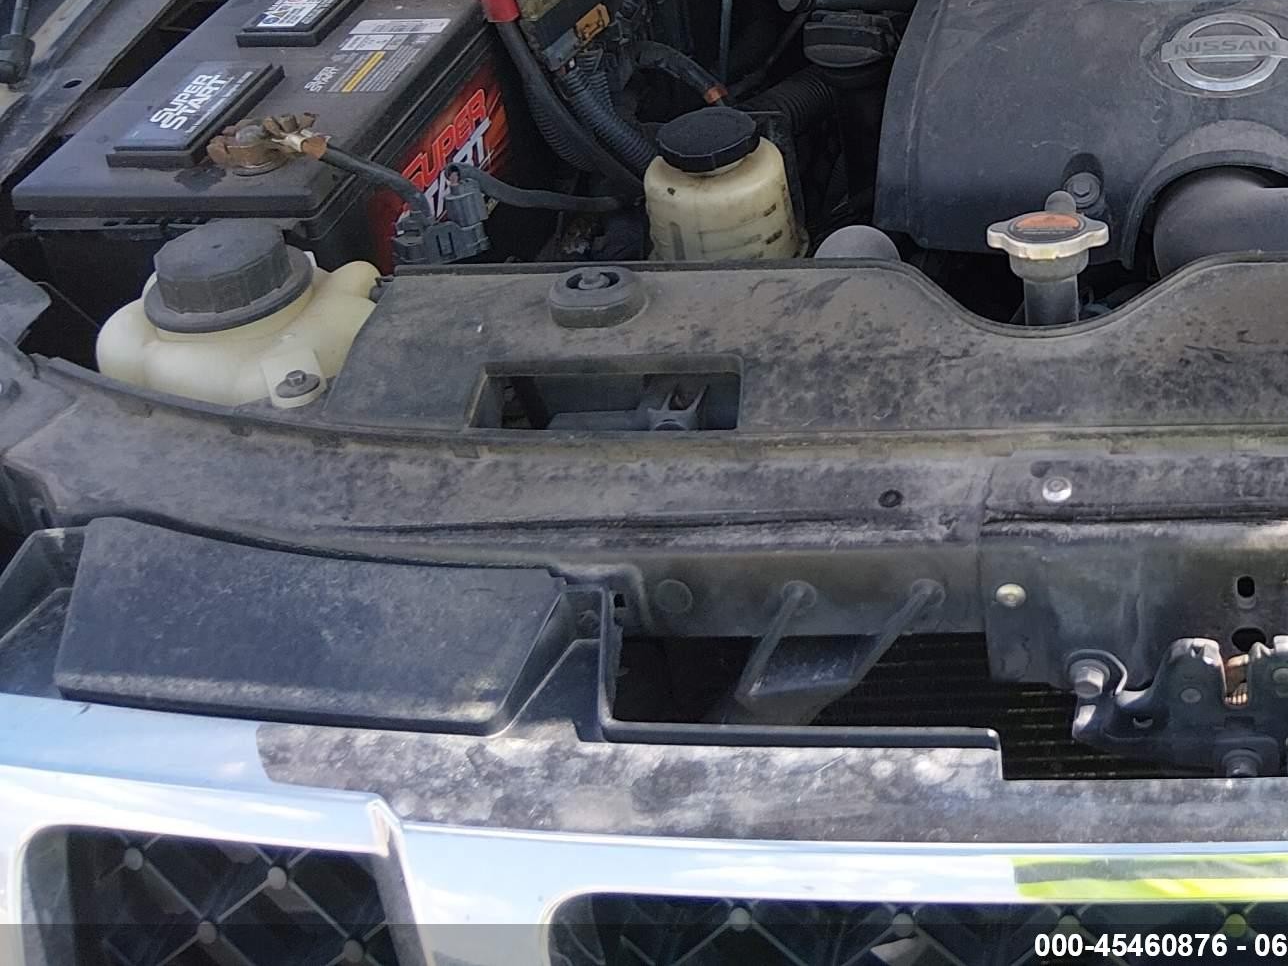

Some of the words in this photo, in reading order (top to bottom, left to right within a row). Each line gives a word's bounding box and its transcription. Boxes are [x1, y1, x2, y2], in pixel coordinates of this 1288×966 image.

[1174, 39, 1277, 55] NISSAN
[150, 74, 213, 123] SUPER
[160, 73, 228, 130] START
[401, 88, 488, 192] SUPER
